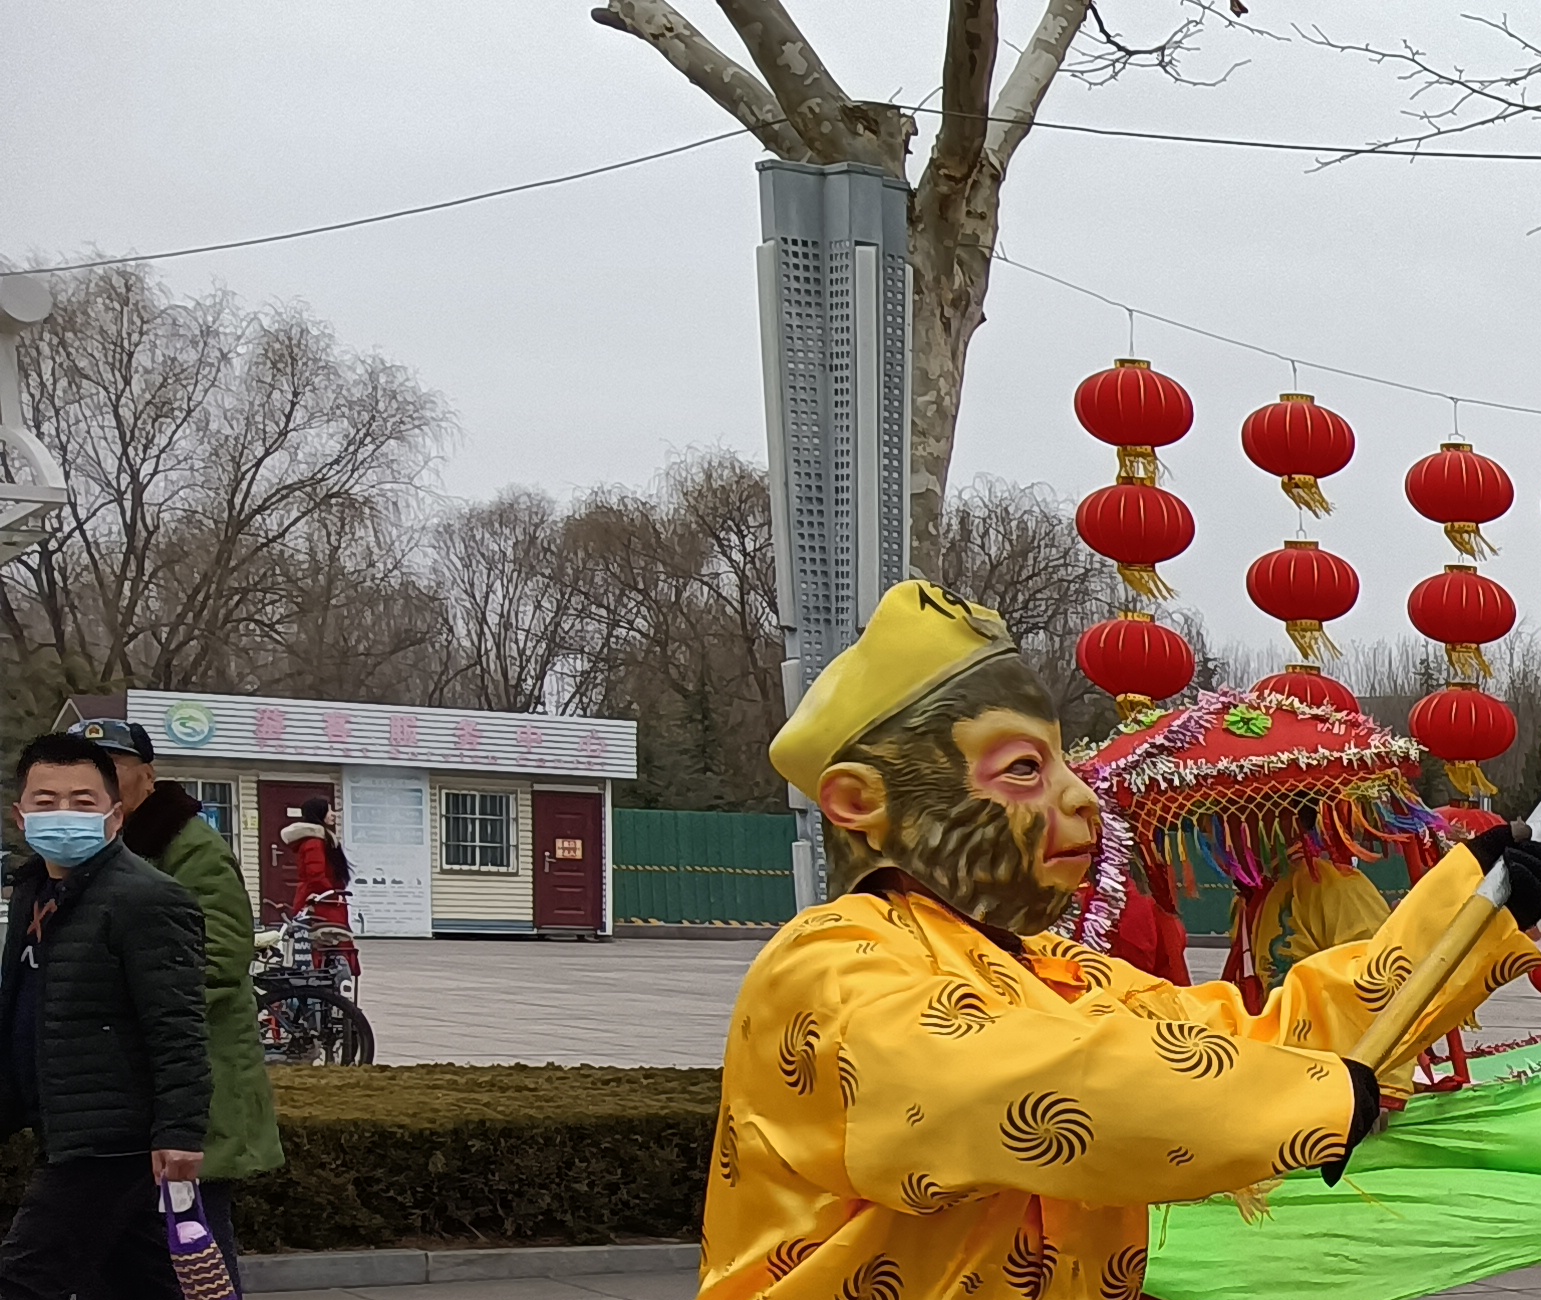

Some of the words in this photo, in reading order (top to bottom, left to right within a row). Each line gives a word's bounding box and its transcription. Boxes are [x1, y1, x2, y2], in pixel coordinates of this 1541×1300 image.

[253, 707, 607, 756] 游客服务中心
